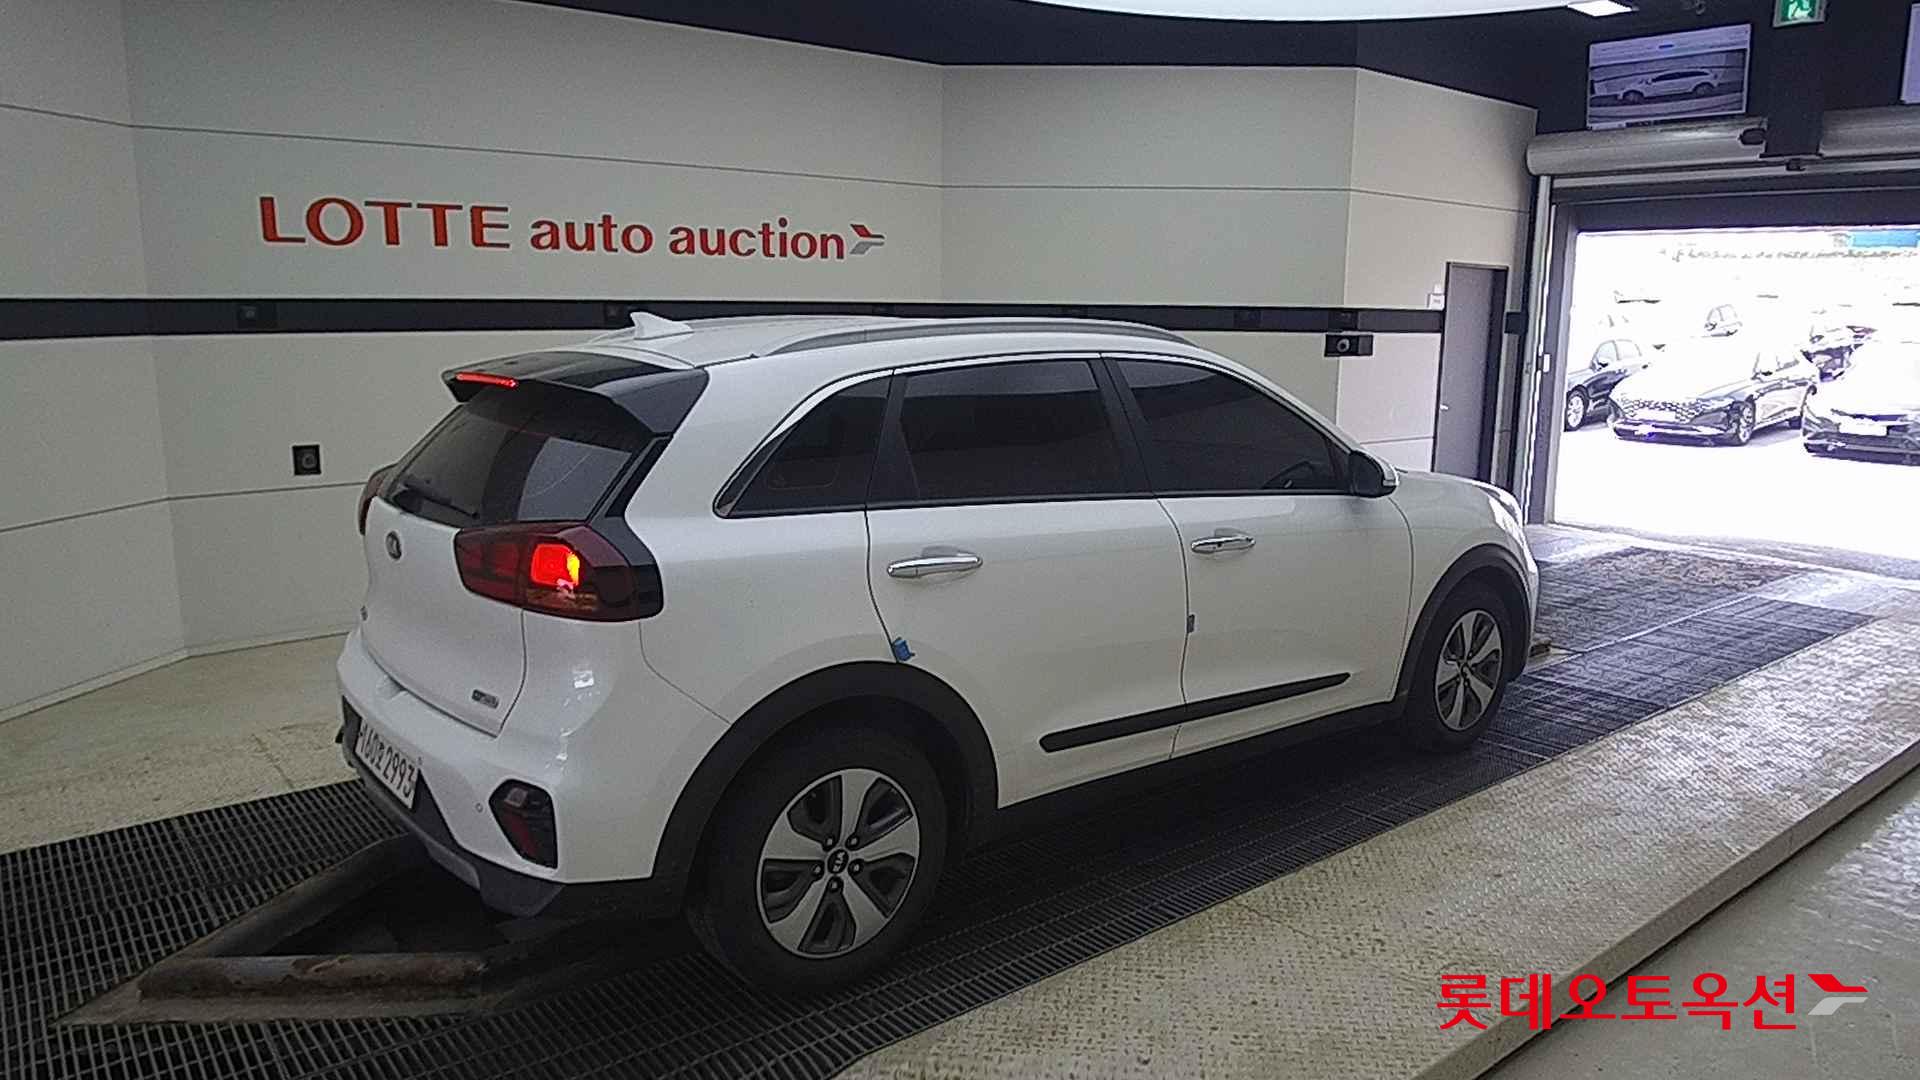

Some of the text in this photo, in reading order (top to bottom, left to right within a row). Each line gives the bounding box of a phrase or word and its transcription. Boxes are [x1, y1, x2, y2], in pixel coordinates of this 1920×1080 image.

[259, 196, 845, 260] LOTTE auto auction
